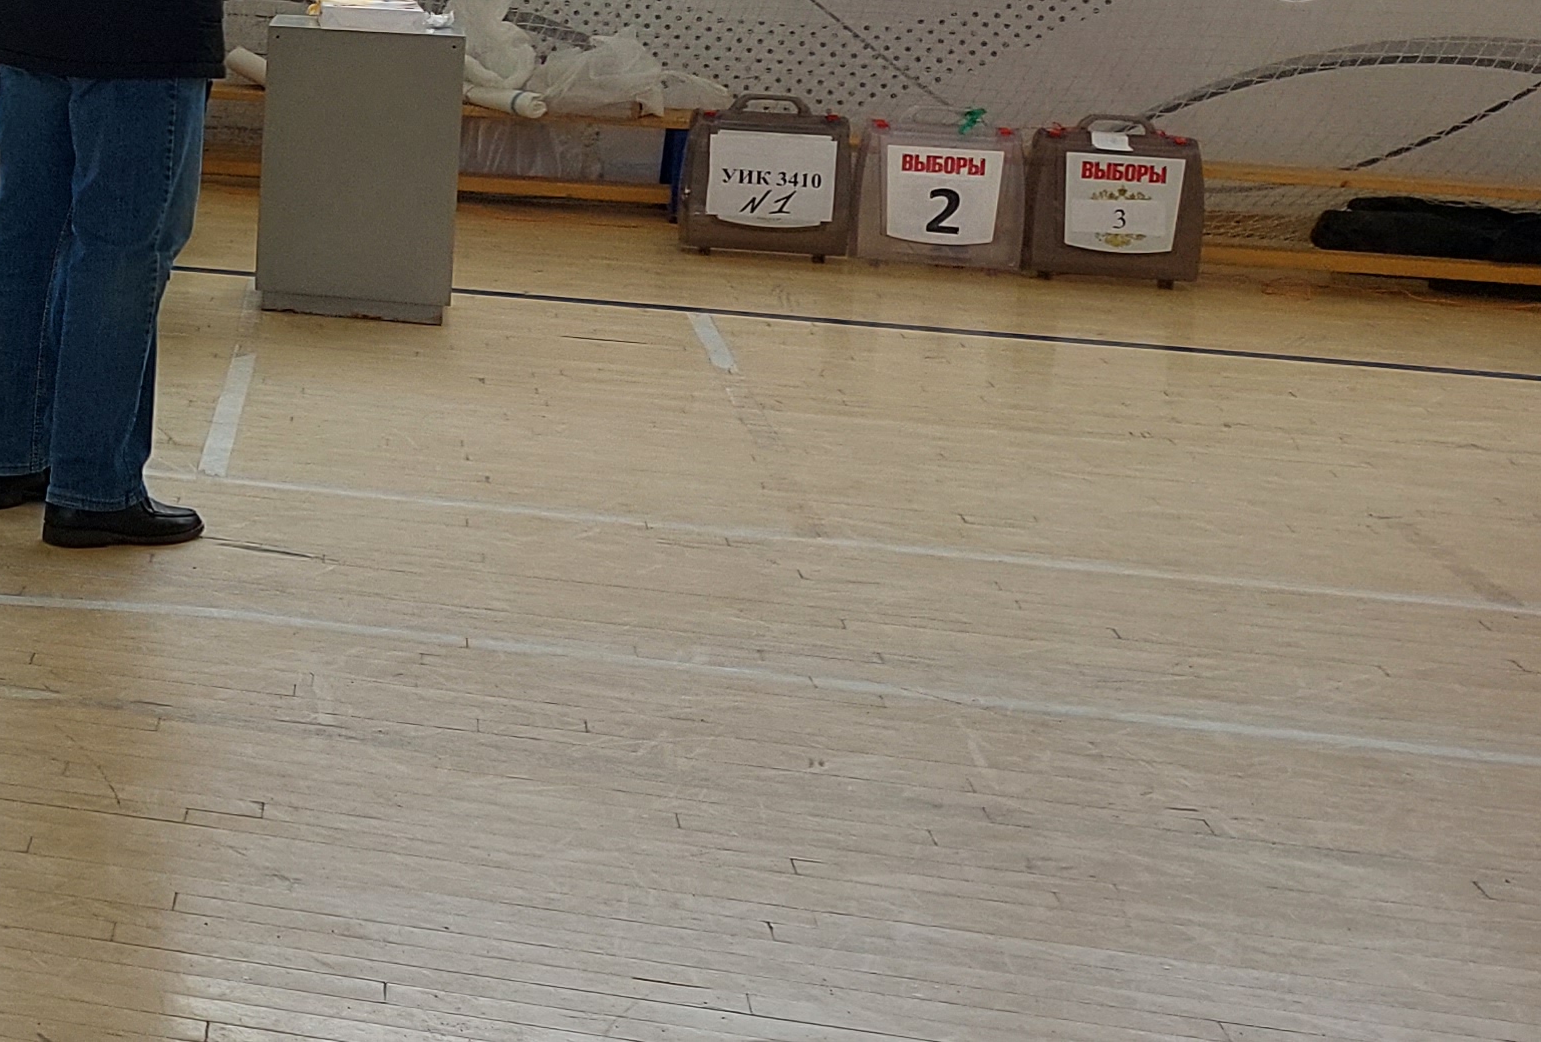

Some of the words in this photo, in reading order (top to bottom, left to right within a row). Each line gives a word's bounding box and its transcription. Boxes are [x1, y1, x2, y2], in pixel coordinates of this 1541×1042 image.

[901, 153, 986, 176] ВЫБОРЫ
[1080, 160, 1167, 184] ВЫБОРЫ
[722, 167, 772, 186] УИК
[776, 171, 822, 189] 3410
[768, 190, 797, 214] 1
[925, 187, 960, 235] 2
[1112, 208, 1127, 229] 3
